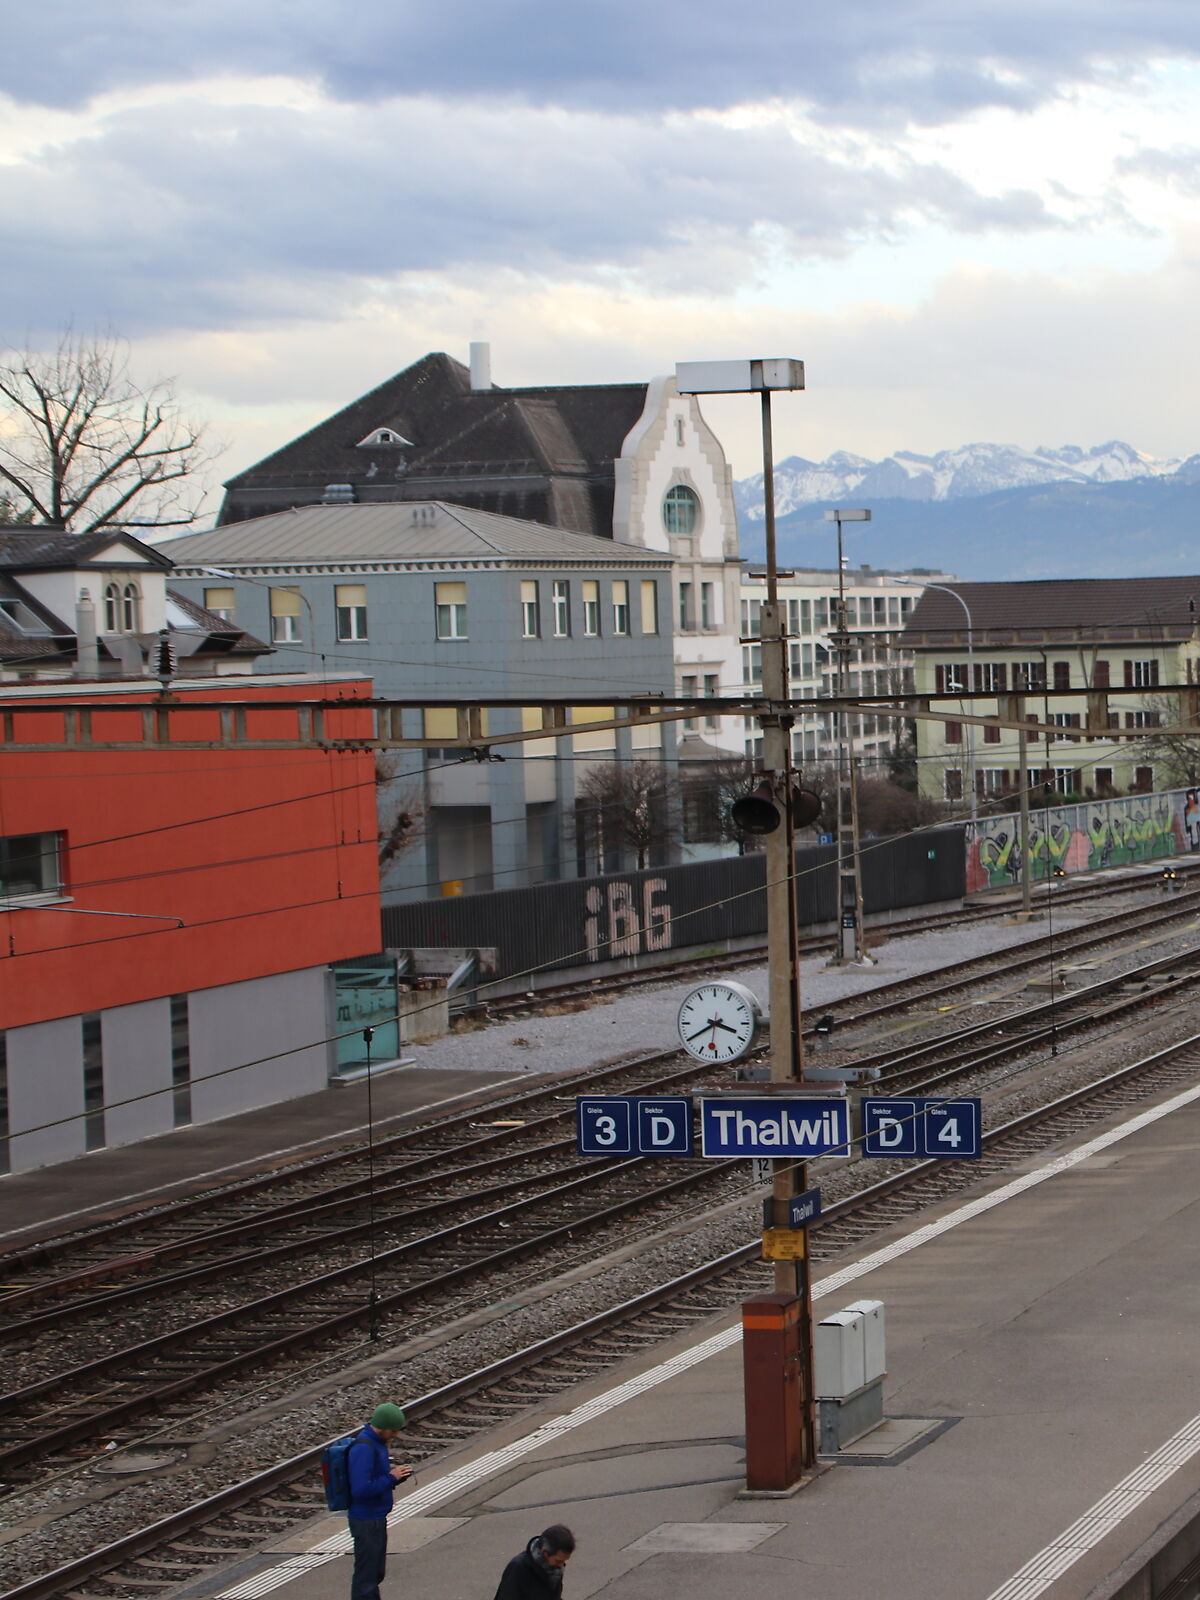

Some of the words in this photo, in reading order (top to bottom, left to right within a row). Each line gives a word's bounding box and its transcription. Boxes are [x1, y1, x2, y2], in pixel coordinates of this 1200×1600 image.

[595, 1116, 617, 1146] 3
[651, 1116, 676, 1146] D
[711, 1110, 839, 1146] Thalwil
[879, 1117, 903, 1147] D
[938, 1118, 962, 1148] 4
[758, 1158, 770, 1171] 12
[793, 1200, 814, 1224] Thalwil
